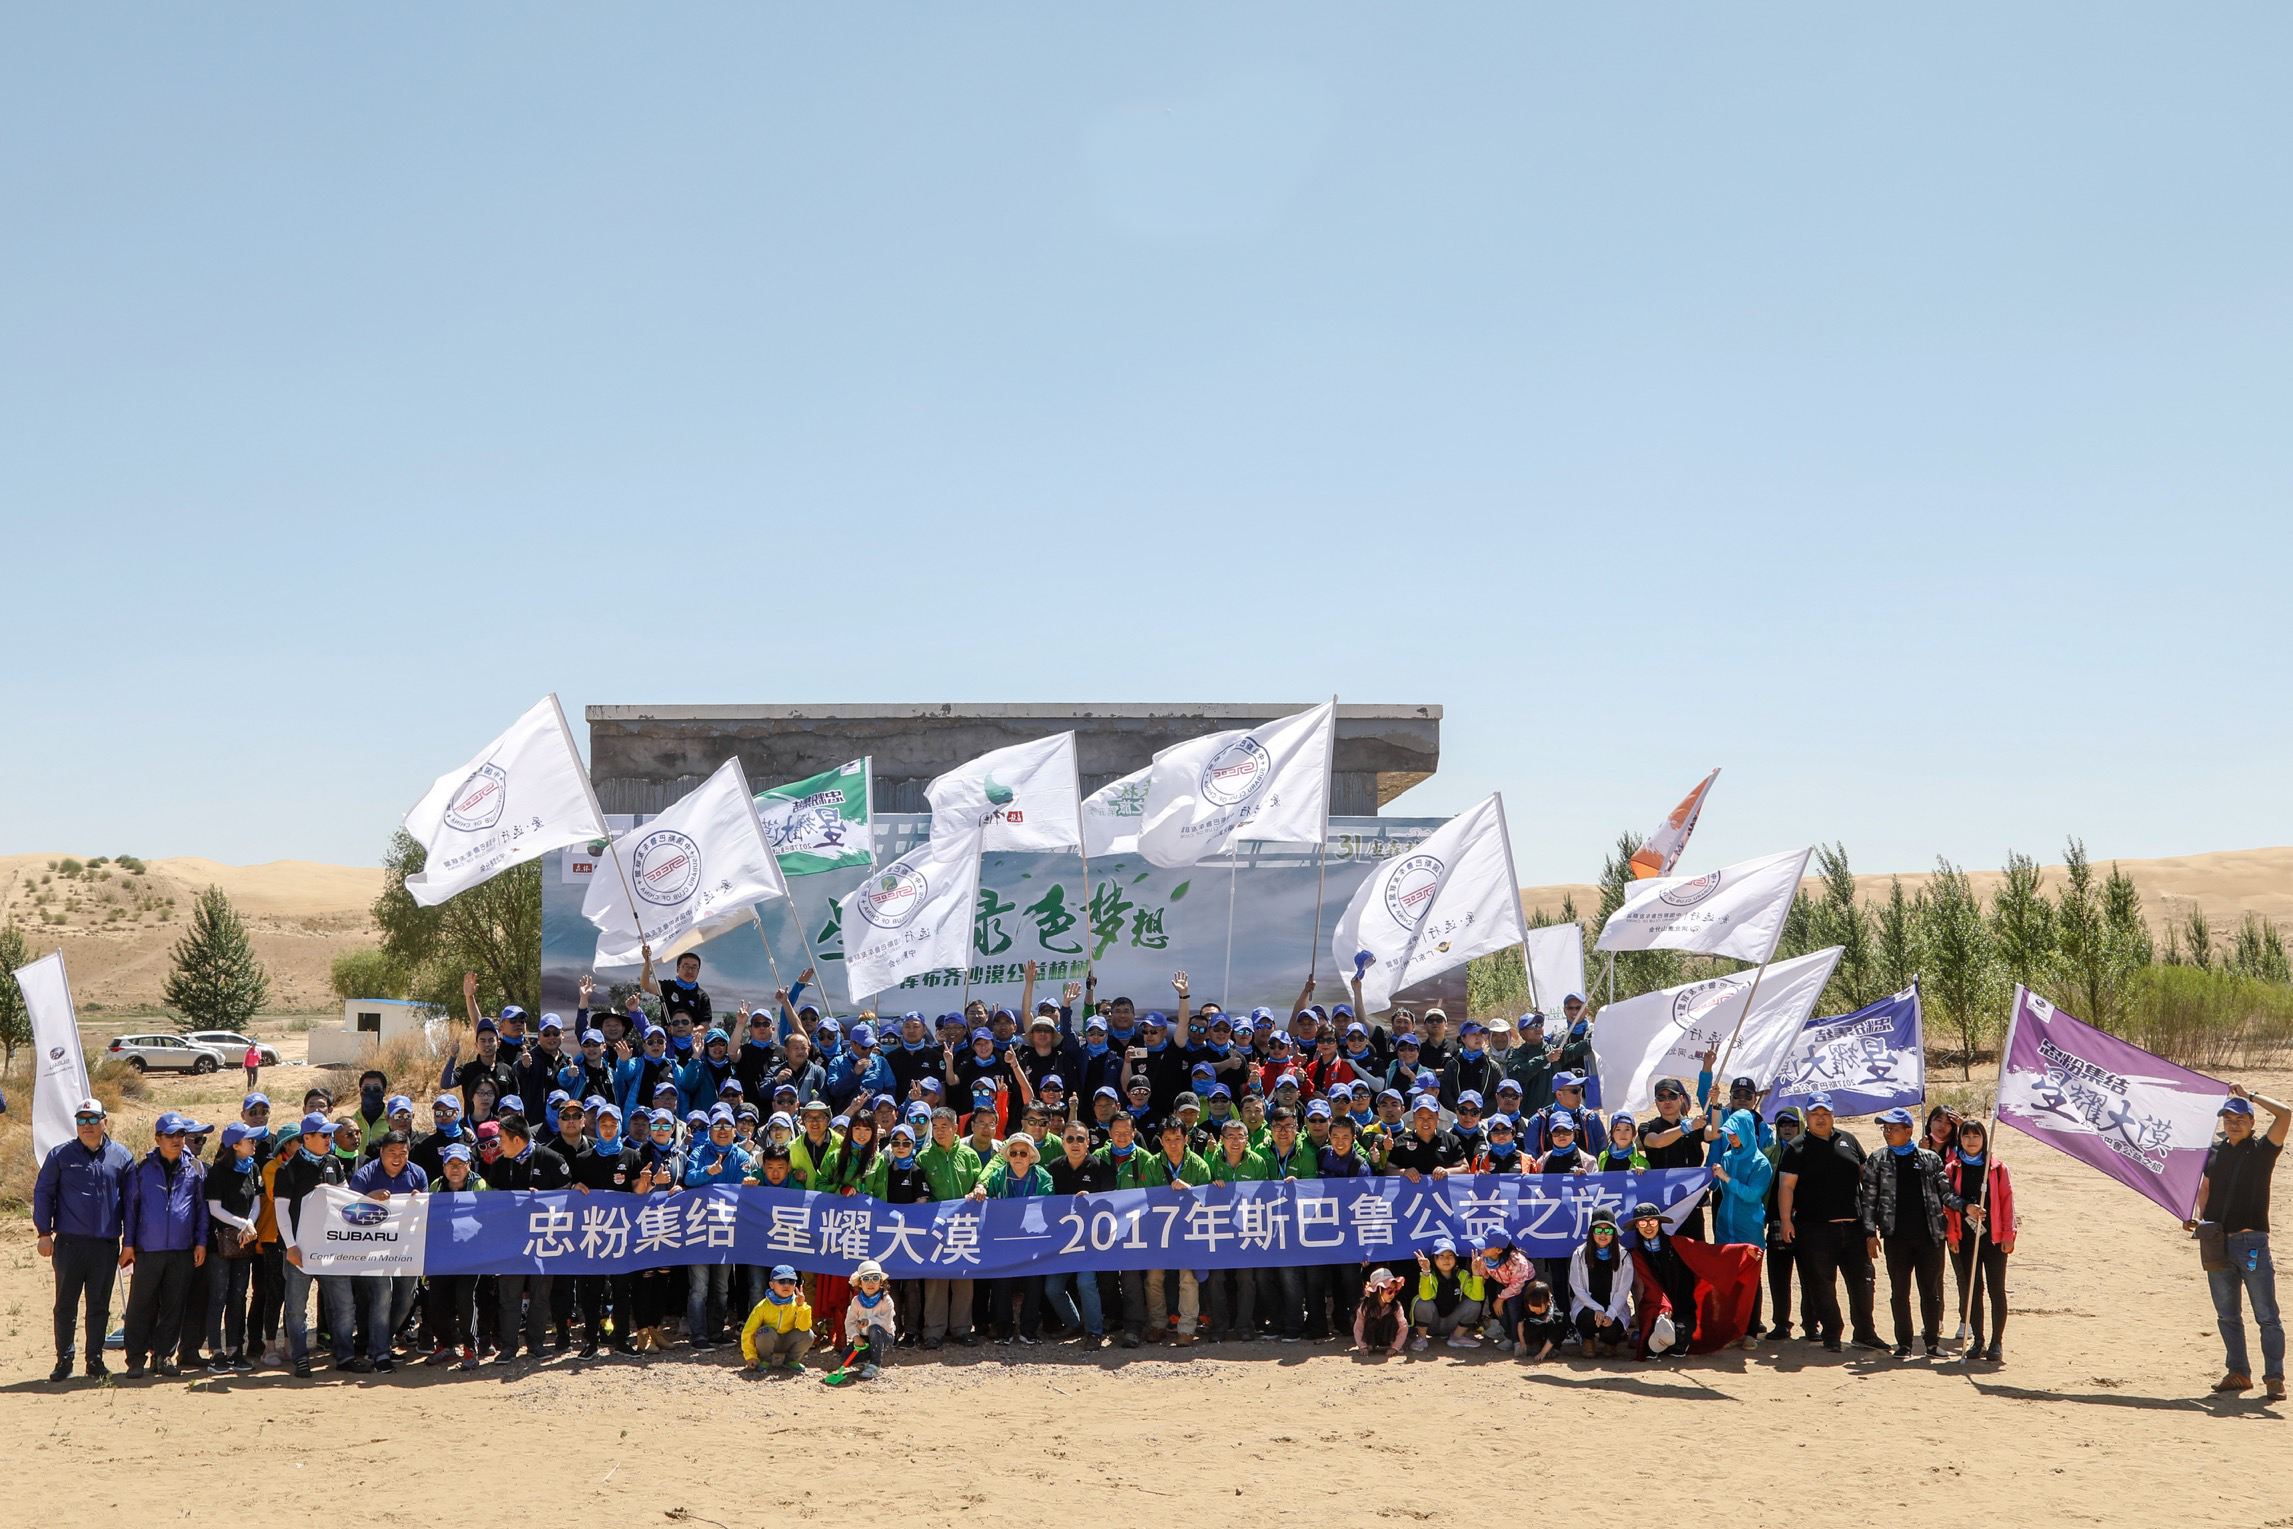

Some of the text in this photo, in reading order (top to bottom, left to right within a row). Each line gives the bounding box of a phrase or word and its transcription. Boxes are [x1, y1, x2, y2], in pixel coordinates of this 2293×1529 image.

[2039, 1040, 2130, 1096] 忠粉集结
[2031, 1064, 2173, 1157] 星耀大漠
[326, 1230, 398, 1242] SUBARU
[523, 1187, 1624, 1265] 忠粉集结 星耀大漠 2017年斯巴鲁公益之旅
[309, 1251, 413, 1263] Confidence in Motion
